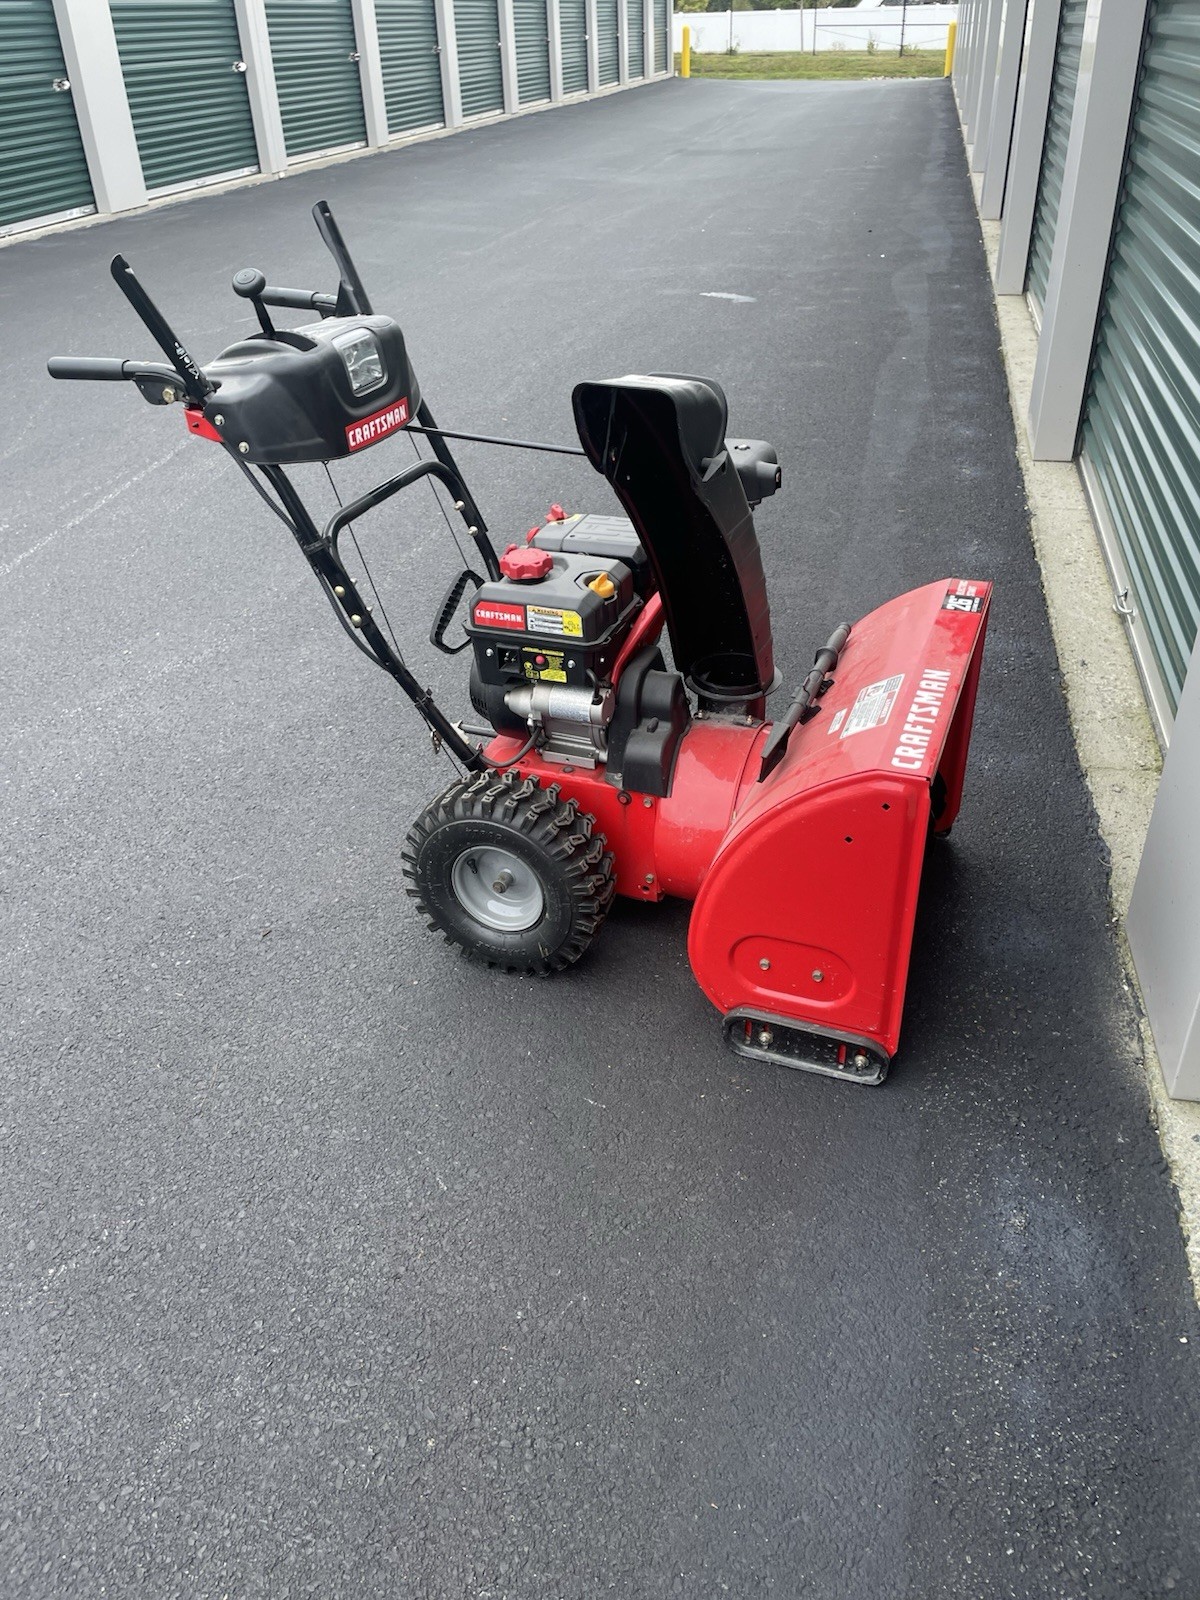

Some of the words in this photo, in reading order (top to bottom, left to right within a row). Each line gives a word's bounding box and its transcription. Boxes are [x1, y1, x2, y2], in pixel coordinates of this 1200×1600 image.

[348, 404, 407, 447] CRAFTSMAN
[475, 609, 523, 622] CRAFTSMAN
[891, 668, 952, 770] CRAFTSMAN
